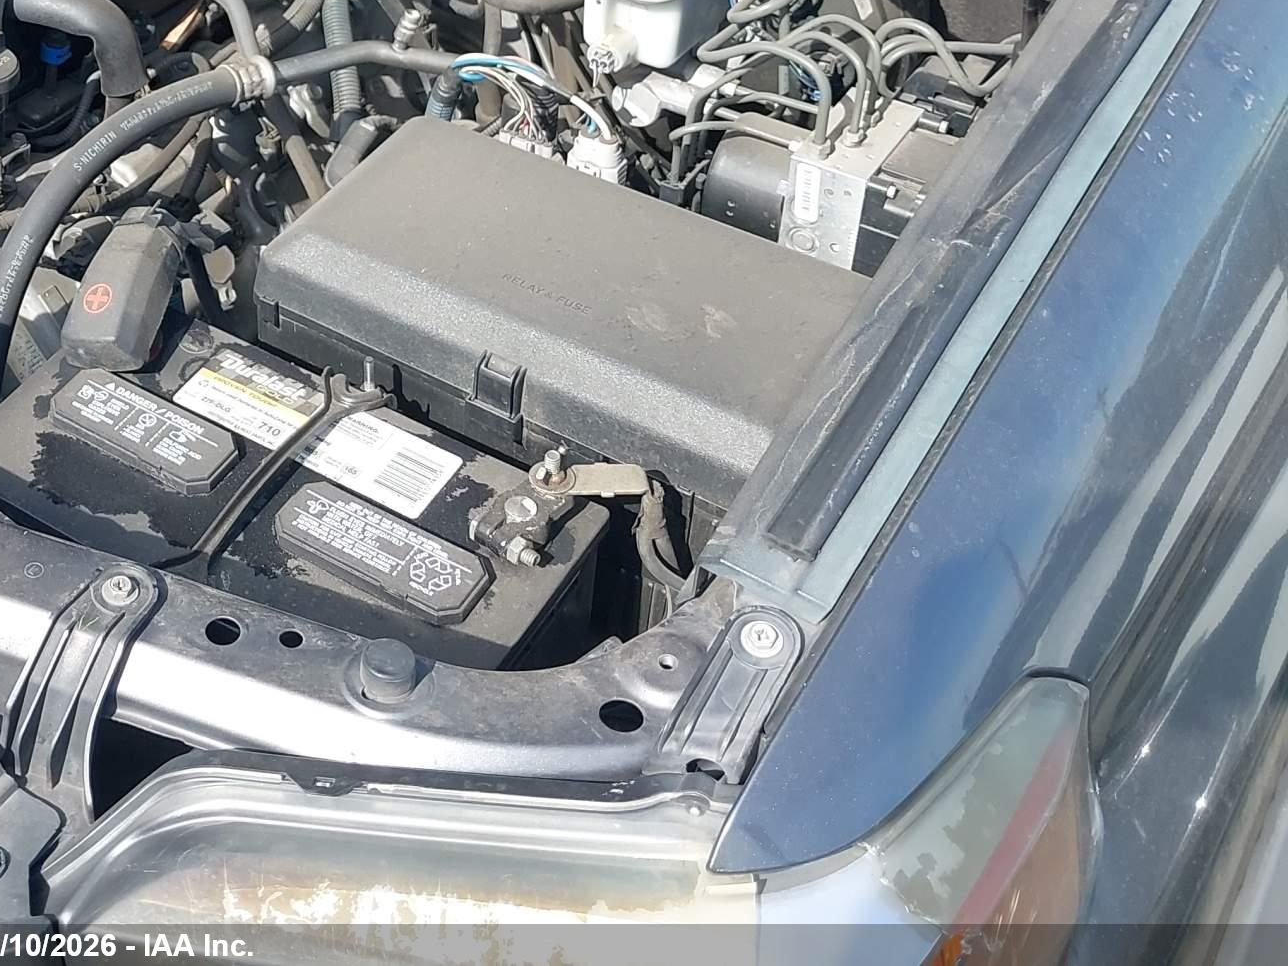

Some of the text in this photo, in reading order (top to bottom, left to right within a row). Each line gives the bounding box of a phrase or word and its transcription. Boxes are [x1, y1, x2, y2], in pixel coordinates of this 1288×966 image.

[502, 273, 545, 294] RELAY
[555, 295, 593, 315] FUSE
[219, 353, 307, 401] Duralast
[255, 384, 294, 404] GOLD
[115, 387, 158, 410] DANGER
[163, 411, 204, 434] POISON
[257, 421, 281, 437] 710
